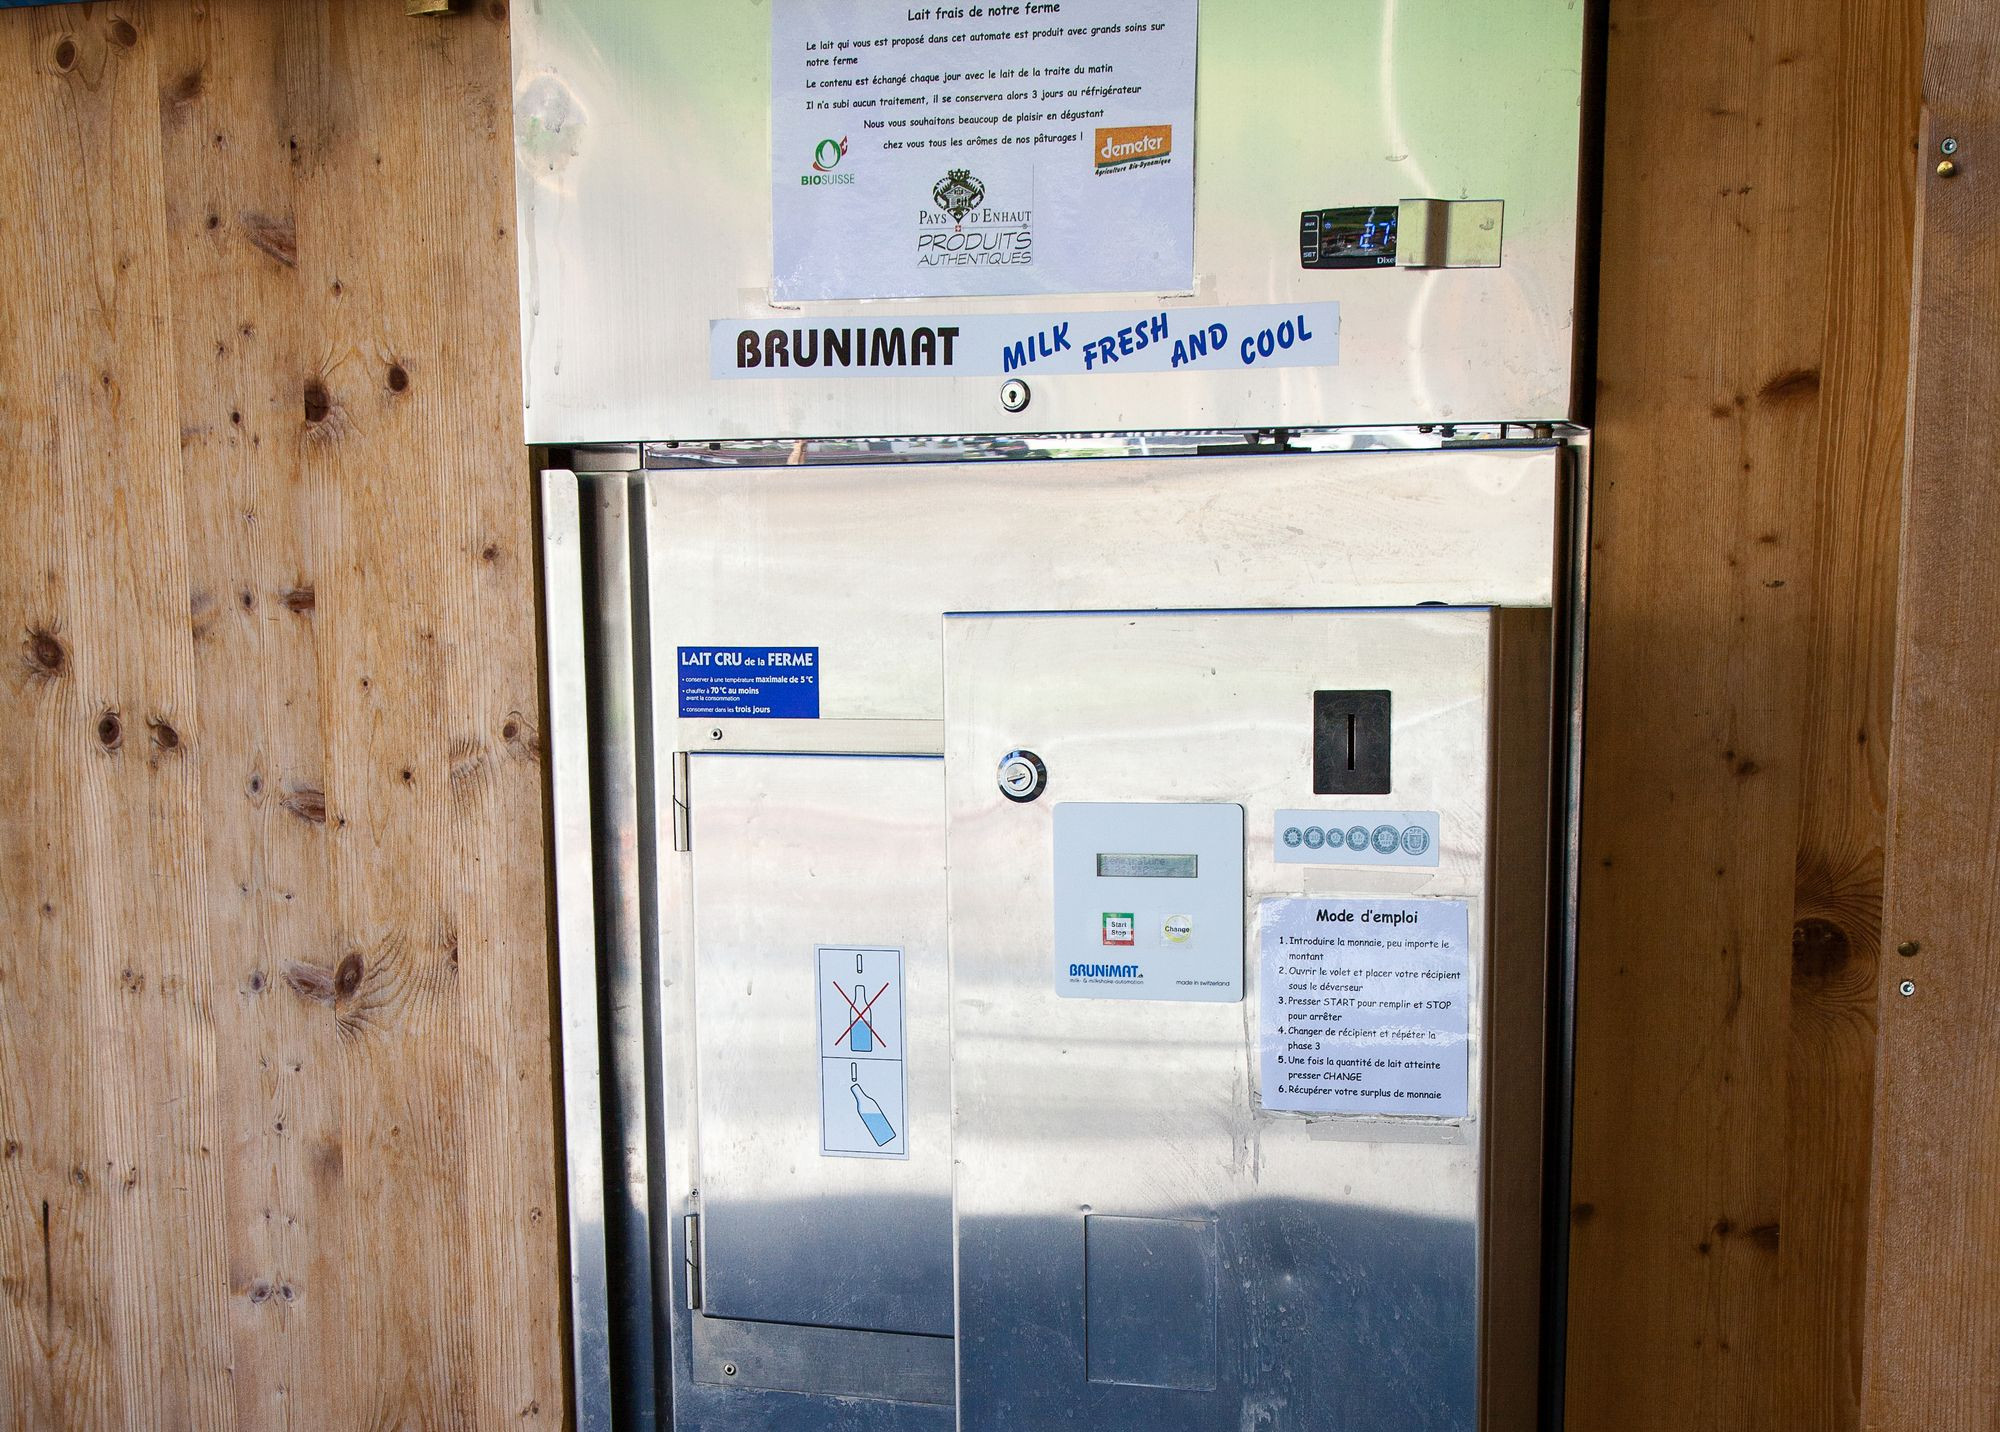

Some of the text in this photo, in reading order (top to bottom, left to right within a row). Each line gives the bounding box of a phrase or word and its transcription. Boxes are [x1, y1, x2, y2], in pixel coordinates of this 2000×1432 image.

[907, 2, 1060, 21] Lait frais de notre ferme
[806, 22, 1165, 51] Le lait qui vous est proposé dans cet automate est produit avec grands soins sur
[806, 55, 858, 67] notre ferme
[806, 63, 1113, 88] Le contenu est échangé chaque jour avec le lait de la traite du matin
[806, 84, 1142, 110] Il n'a subi aucun traitement, il se conservera alors 3 jours au réfrigérateur
[863, 119, 885, 129] Nous
[887, 119, 906, 127] vous
[909, 116, 955, 126] souhaitons
[958, 115, 998, 125] beaucoup
[1001, 113, 1013, 122] de
[1016, 111, 1043, 125] plaisir
[1060, 108, 1104, 122] dégustant
[883, 139, 903, 149] chez
[906, 140, 925, 148] vous
[928, 139, 947, 147] tous
[950, 137, 963, 146] les
[966, 135, 998, 146] arômes
[1001, 135, 1012, 144] de
[1015, 136, 1030, 144] nos
[1033, 132, 1077, 146] pâturages
[1101, 136, 1163, 158] demeter
[1095, 166, 1127, 177] Agriculture
[917, 231, 1032, 251] PRODUITS
[917, 252, 1032, 266] AUTHENTIQUES
[737, 312, 1312, 373] BRUNIMAT MILK FRESH AND COOL
[681, 651, 813, 666] LAIT CRU de la FERME
[755, 675, 788, 683] maximale
[738, 686, 759, 694] moins
[734, 705, 770, 714] trois jours
[1316, 908, 1418, 927] Mode d'emploi
[1111, 929, 1127, 937] Stop
[1164, 925, 1190, 934] Change
[1289, 936, 1450, 950] Introduire la monnaie, peu importe le
[1288, 952, 1324, 961] montant
[1288, 966, 1317, 975] Ouvrir
[1319, 966, 1327, 976] le
[1329, 967, 1351, 976] volet
[1365, 968, 1392, 979] placer
[1394, 970, 1419, 978] votre
[1421, 969, 1461, 981] récipient
[1309, 981, 1317, 991] le
[1319, 981, 1363, 992] déverseur
[1288, 996, 1452, 1010] Presser START pour remplir et STOP
[1288, 1011, 1342, 1022] pour arrêter
[1287, 1026, 1436, 1040] Changer de récipient et répéter la
[1287, 1041, 1320, 1052] phase 3
[1288, 1055, 1441, 1070] Une fois la quantité de lait atteinte
[1288, 1071, 1362, 1081] presser CHANGE
[1288, 1084, 1442, 1099] Récupérer votre surplus de monnaie
